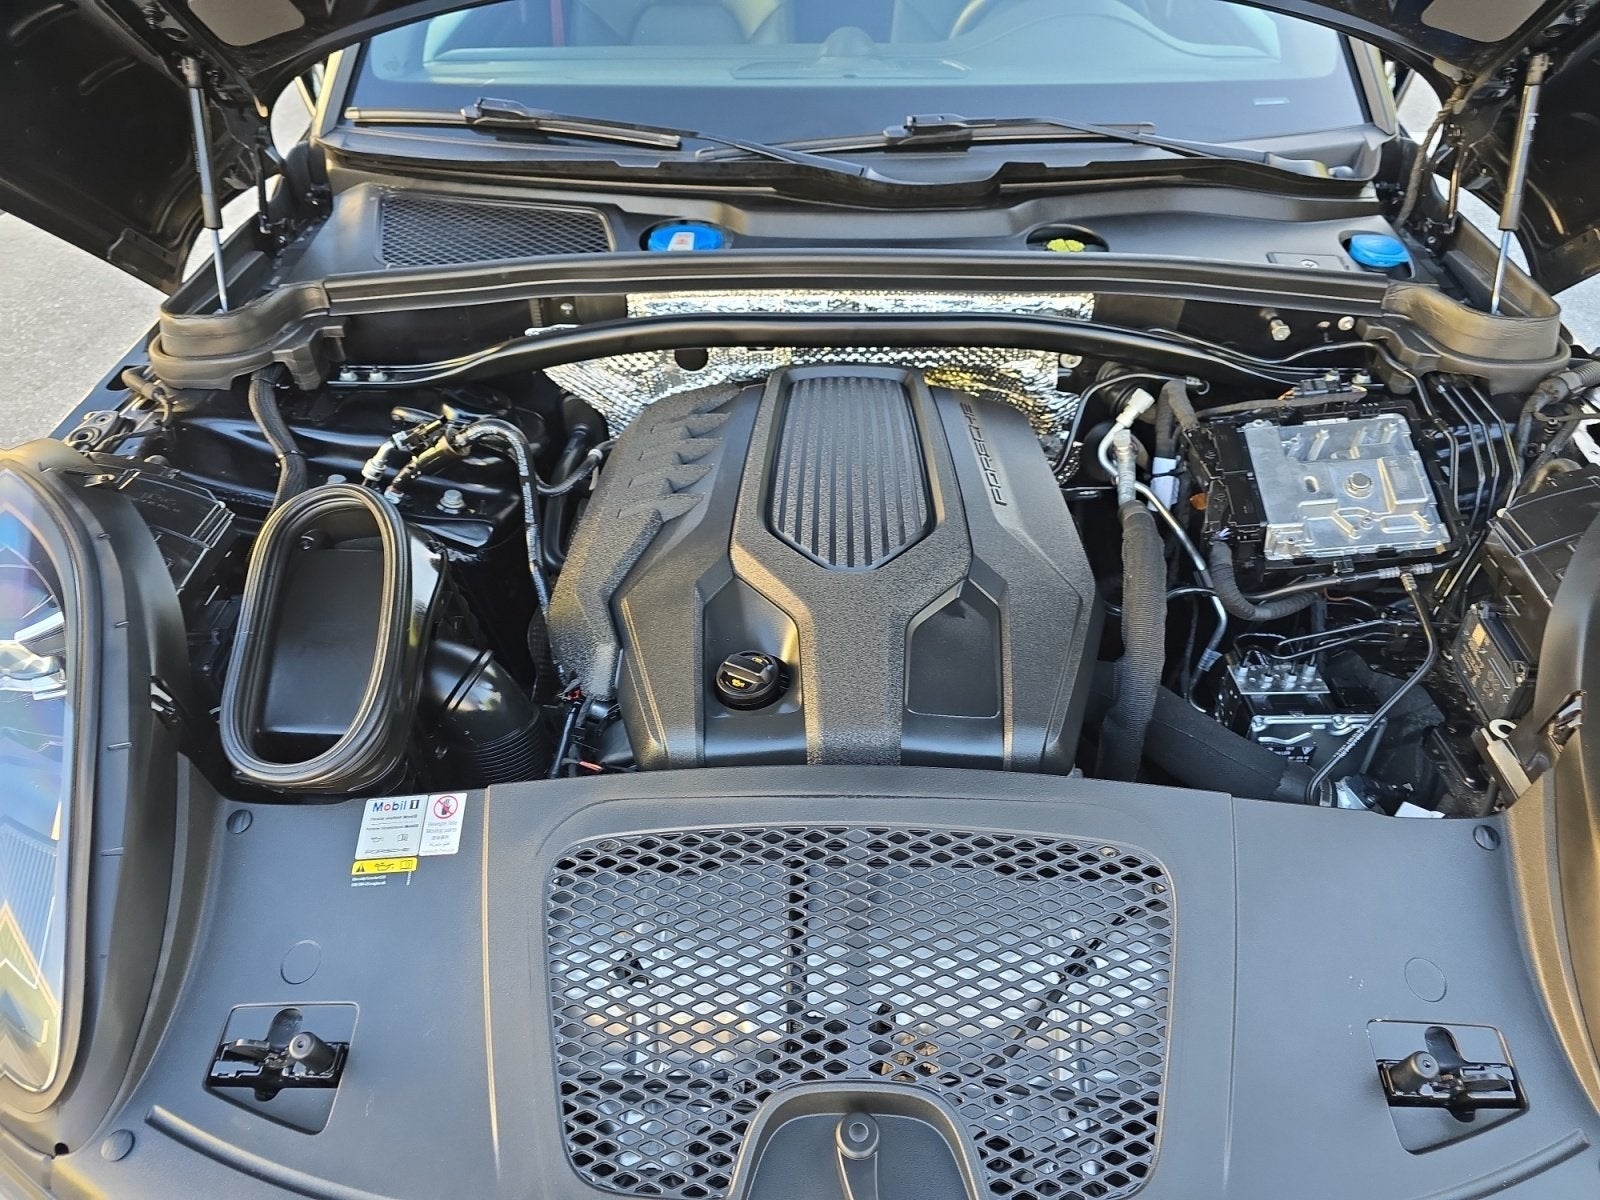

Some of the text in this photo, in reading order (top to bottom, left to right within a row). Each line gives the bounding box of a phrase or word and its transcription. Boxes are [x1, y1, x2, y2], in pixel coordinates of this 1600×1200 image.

[960, 402, 1007, 506] PORSCHE
[373, 800, 420, 812] Mobil 1
